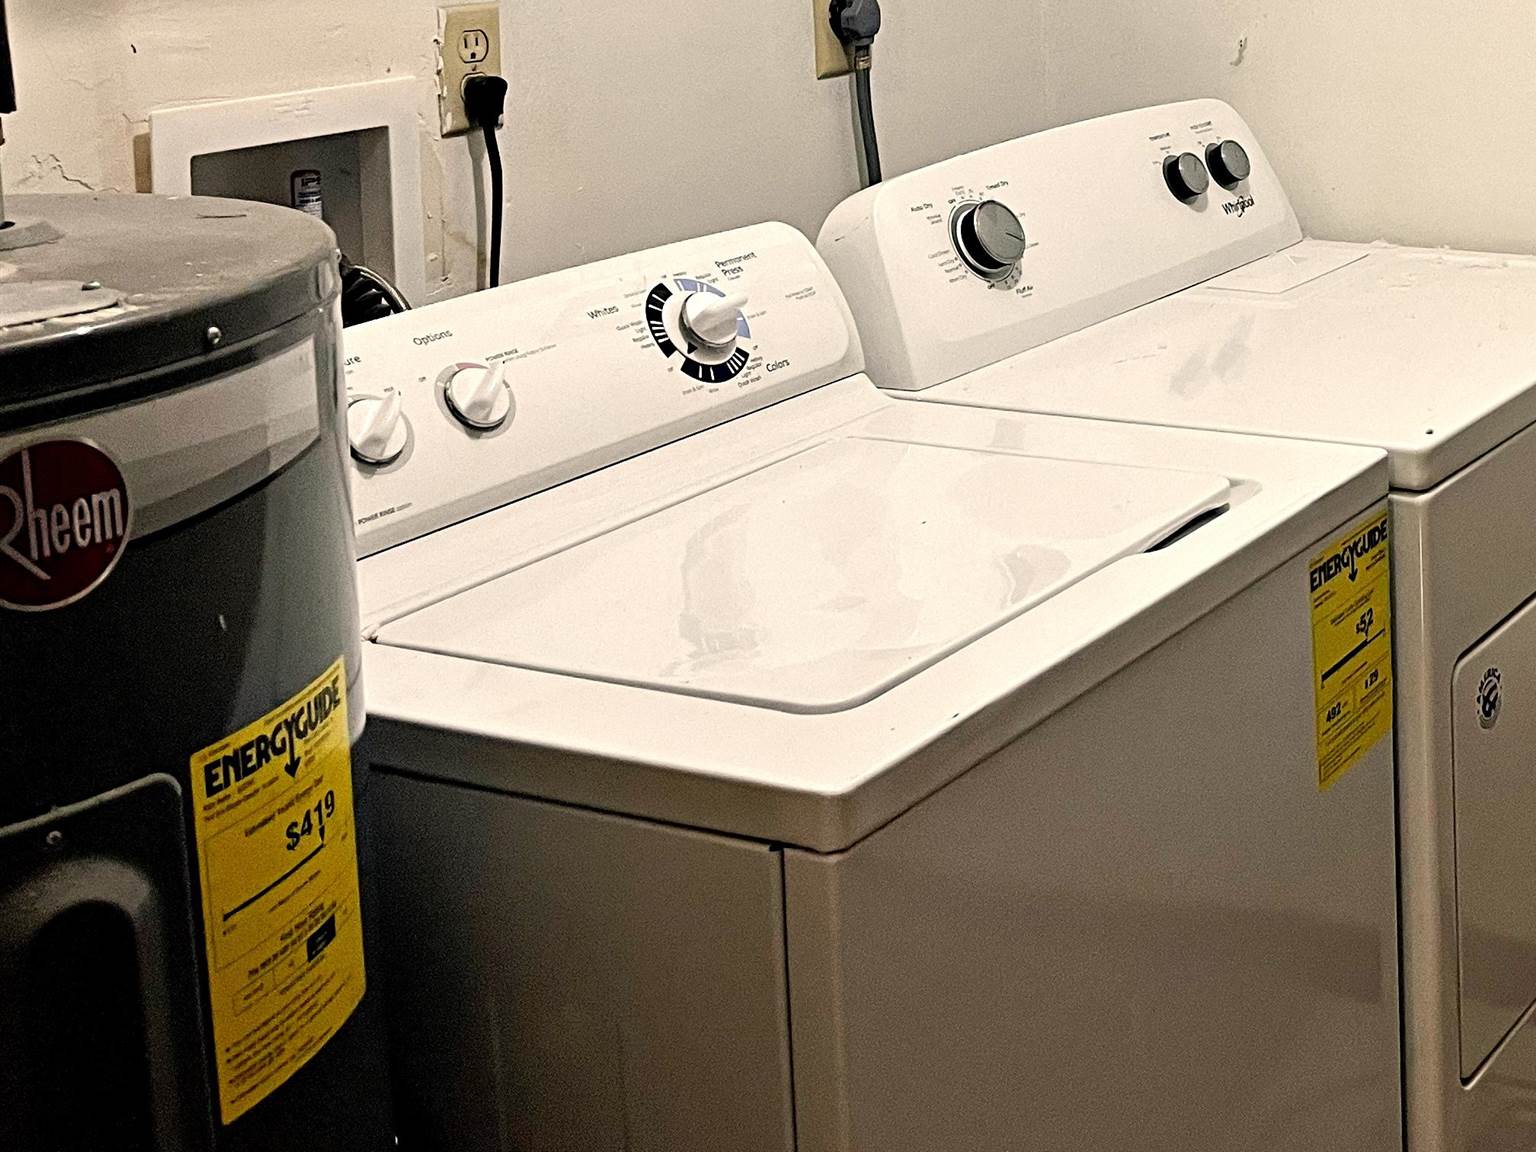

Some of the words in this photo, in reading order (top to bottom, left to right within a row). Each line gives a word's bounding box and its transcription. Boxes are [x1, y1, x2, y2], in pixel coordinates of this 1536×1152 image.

[1221, 194, 1255, 218] Whirlpool
[714, 251, 757, 268] Permanent
[721, 266, 744, 277] Press
[586, 305, 619, 319] Whites
[413, 329, 454, 346] Options
[765, 358, 791, 373] Colors
[0, 448, 124, 581] Rheem
[1310, 517, 1388, 593] ENERGYGUIDE
[204, 675, 341, 798] ENERGYGUIDE
[285, 789, 335, 851] $419
